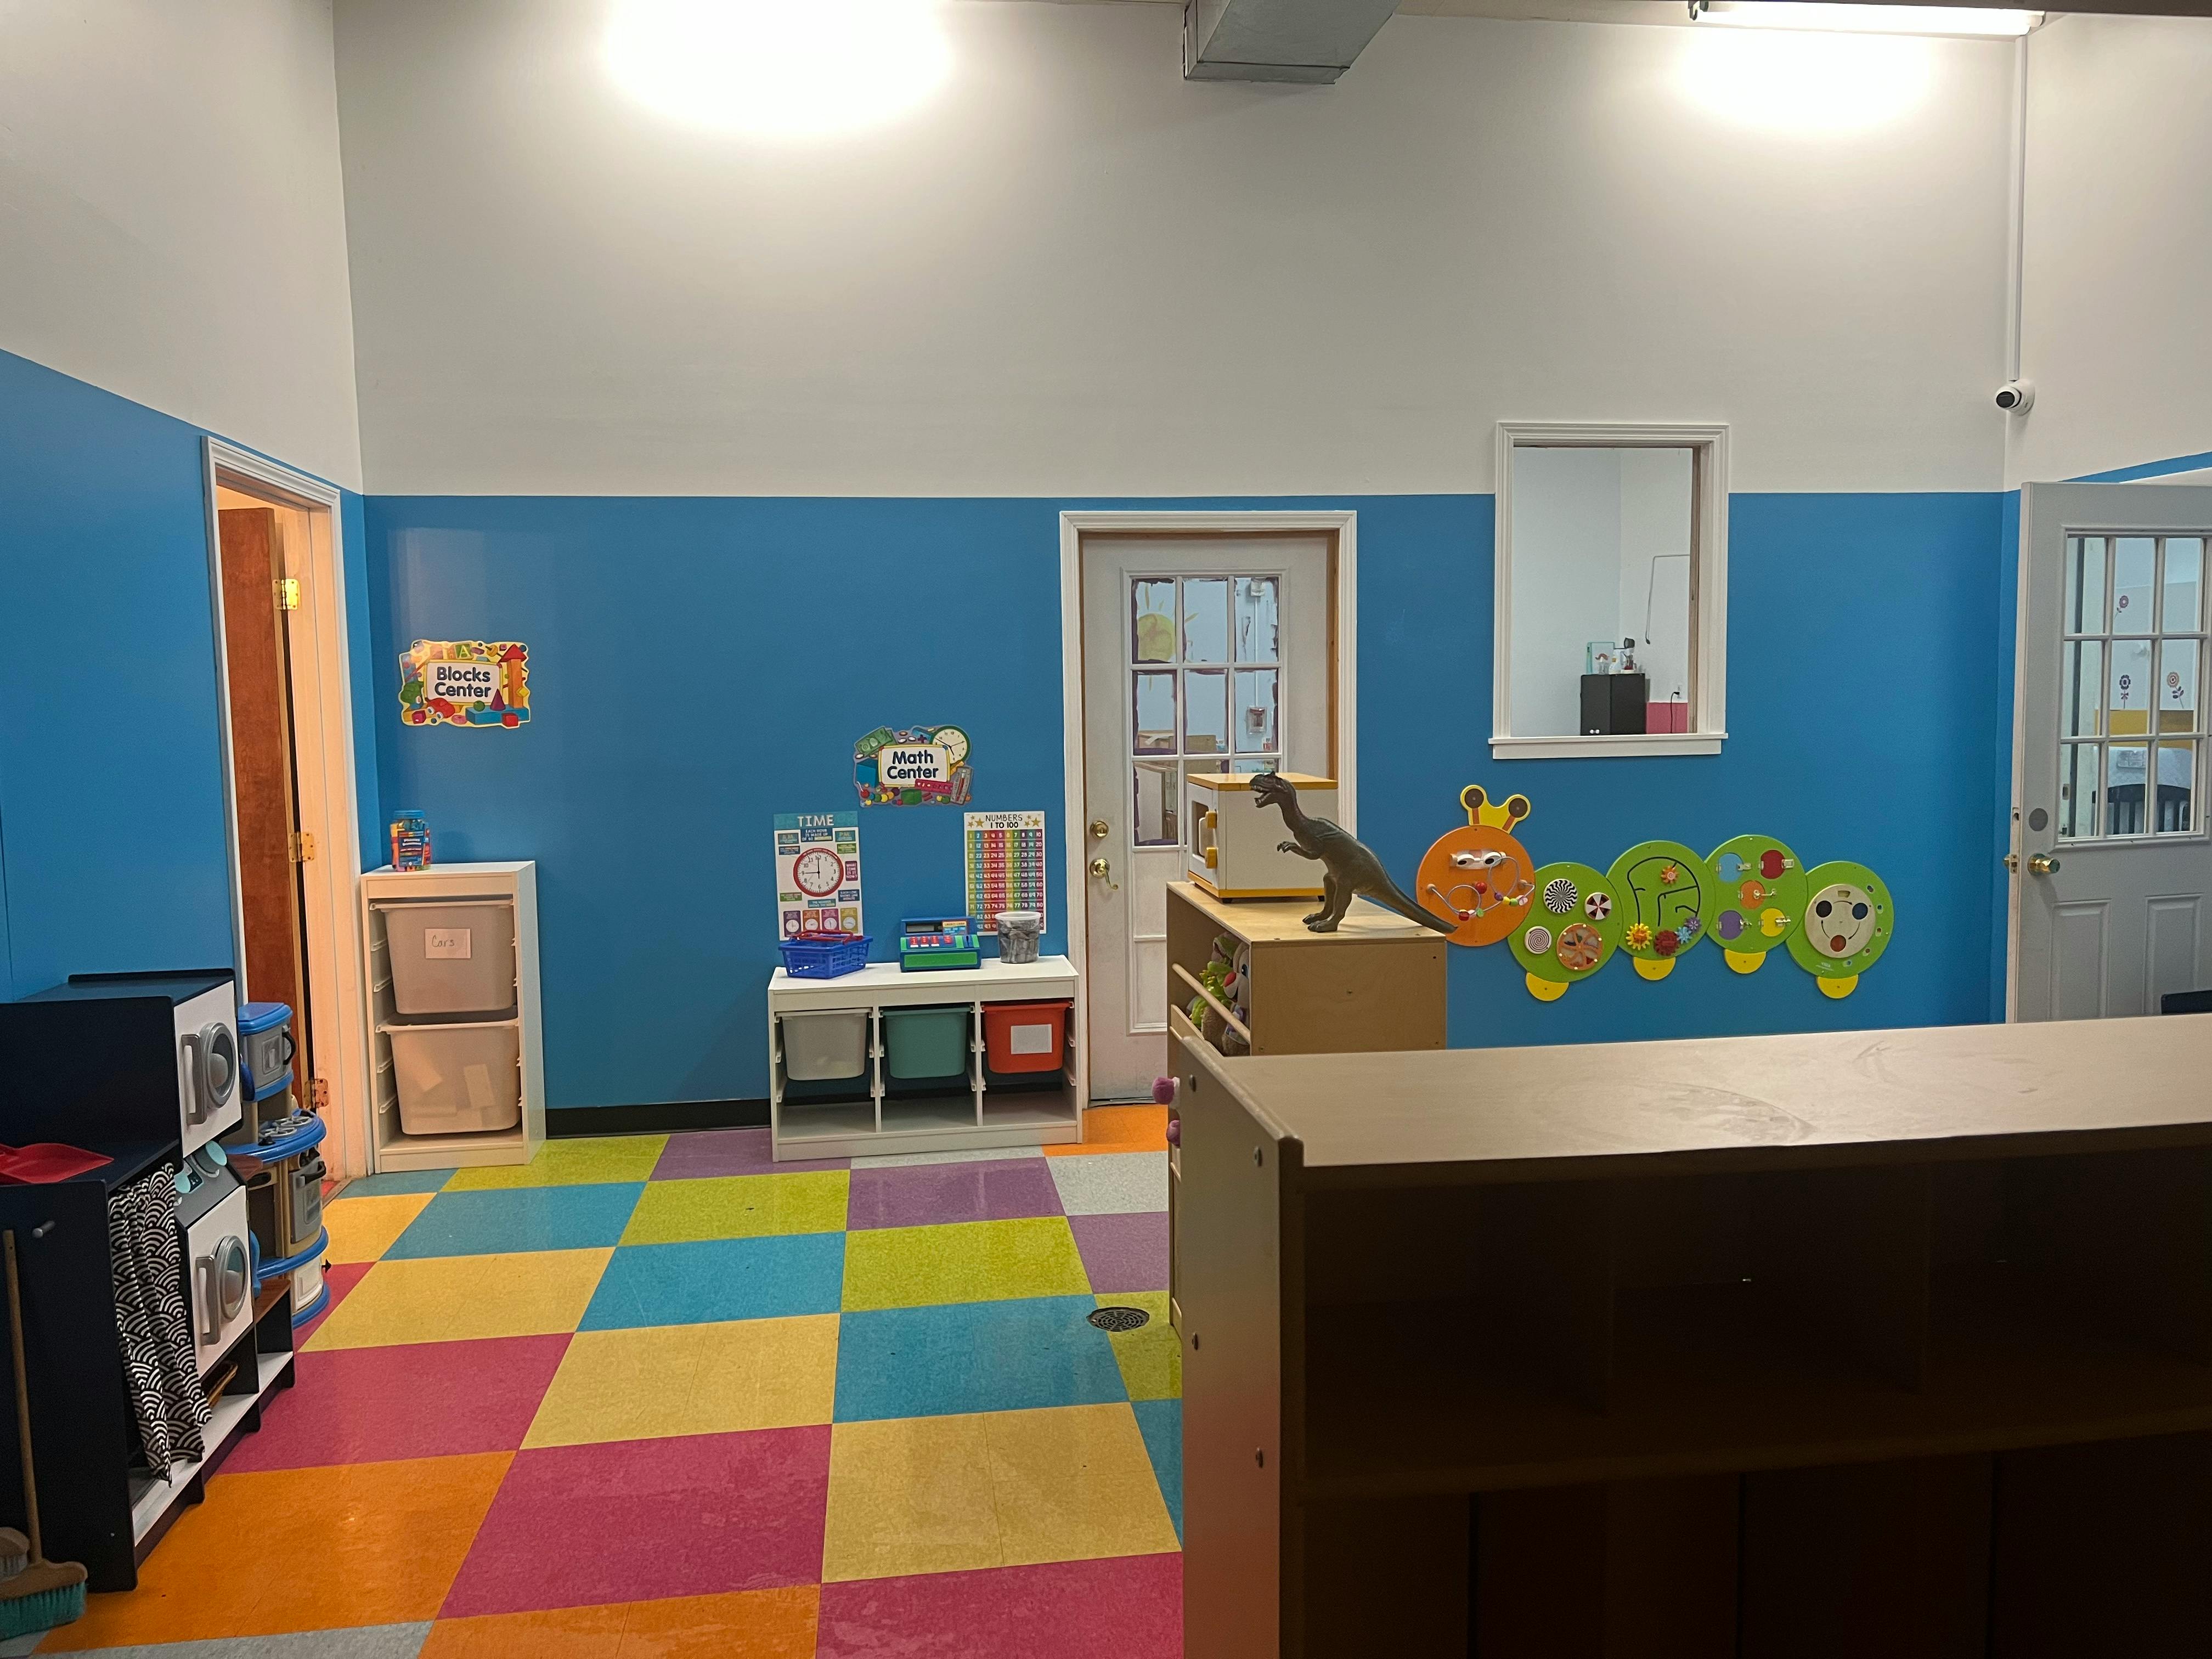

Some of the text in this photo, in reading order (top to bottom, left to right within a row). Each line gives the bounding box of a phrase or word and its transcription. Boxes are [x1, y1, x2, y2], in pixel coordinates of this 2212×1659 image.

[460, 645, 471, 658] A
[437, 666, 490, 682] Blocks
[435, 682, 492, 698] Center
[892, 749, 934, 765] Math
[887, 766, 939, 779] Center
[797, 814, 834, 827] TIME
[431, 934, 455, 947] Cars
